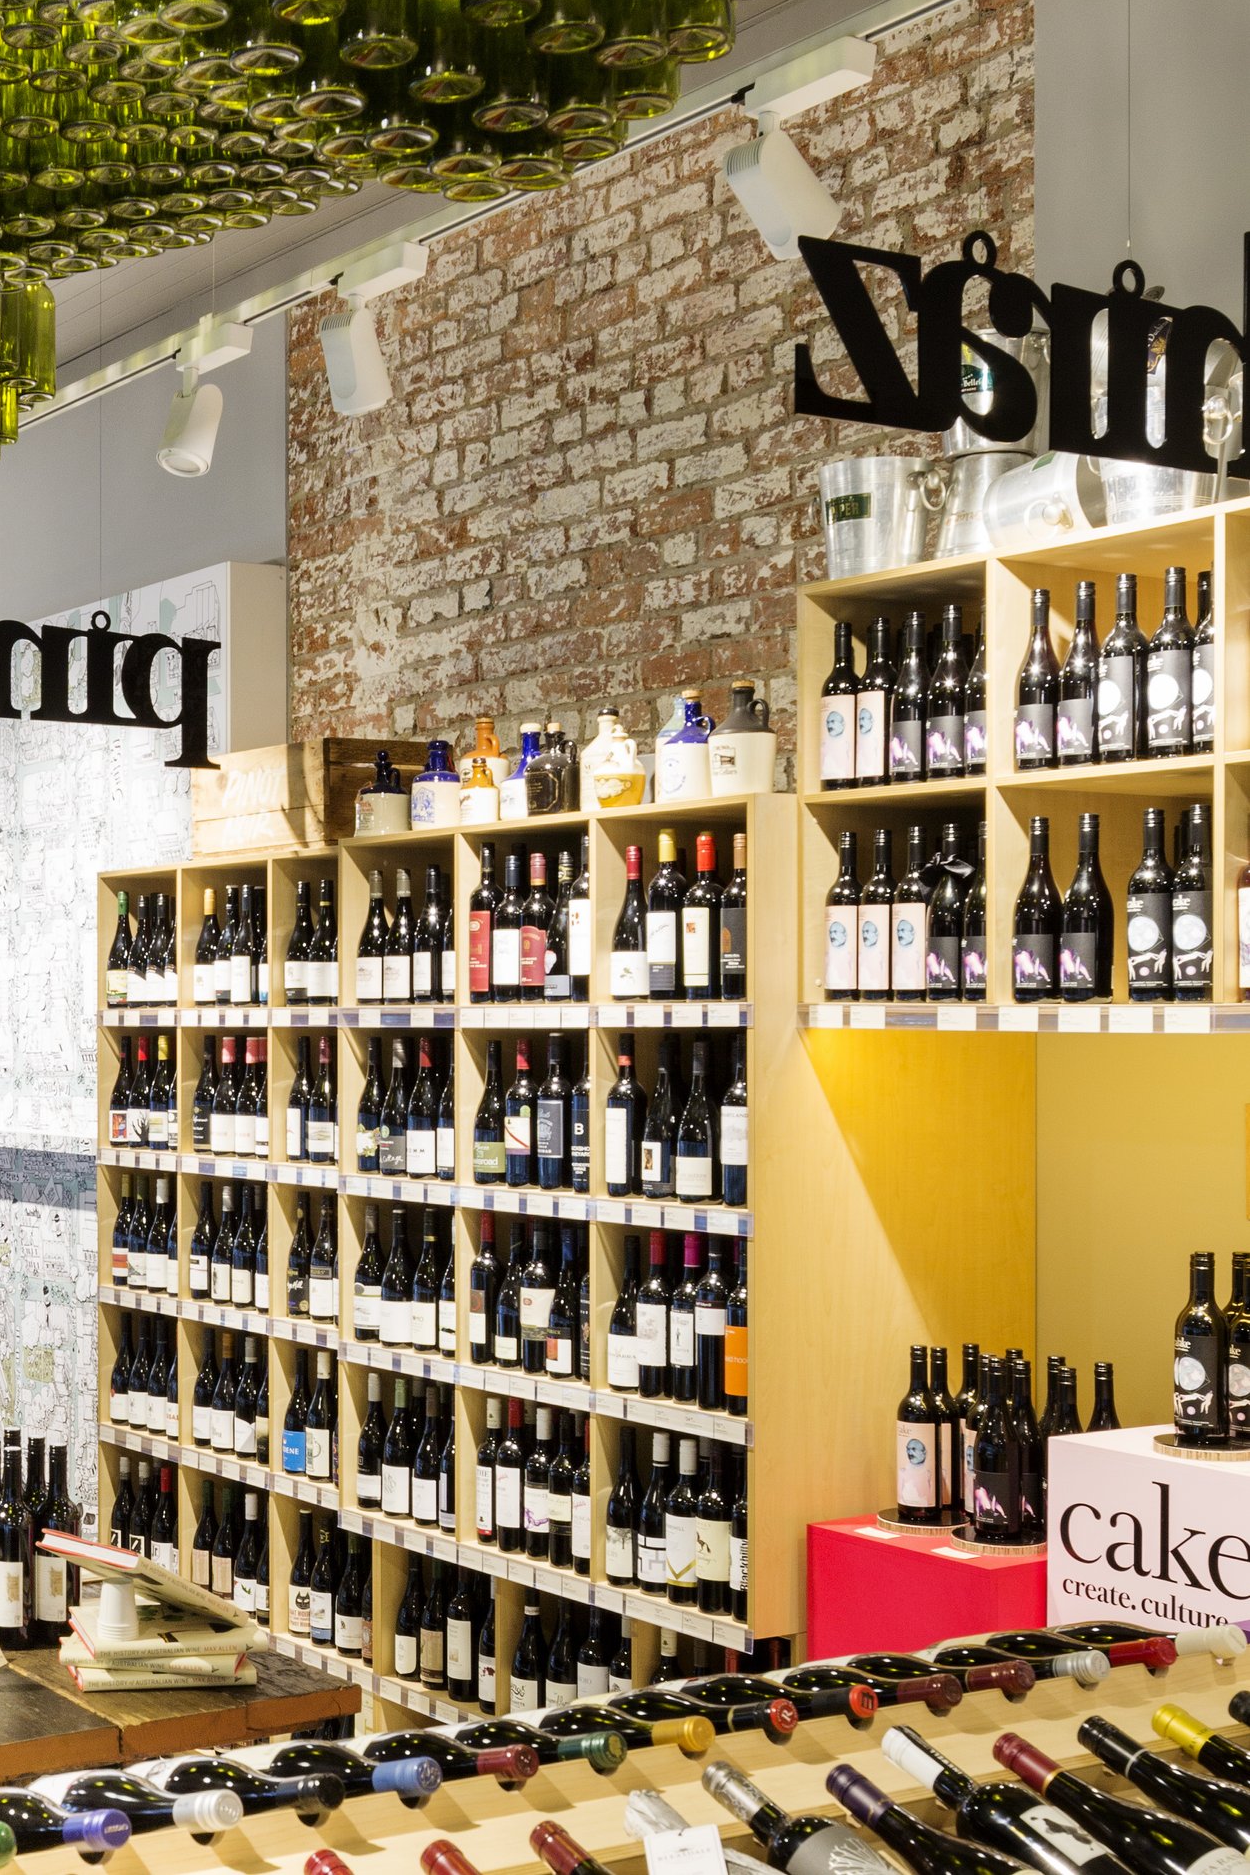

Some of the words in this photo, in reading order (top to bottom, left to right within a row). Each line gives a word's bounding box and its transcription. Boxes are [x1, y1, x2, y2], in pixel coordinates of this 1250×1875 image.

[1060, 1481, 1250, 1601] cake
[1063, 1578, 1136, 1611] create.
[110, 1650, 140, 1658] HISTORY
[147, 1648, 184, 1656] AUSTRALIAN
[219, 1644, 238, 1652] ALLEN
[111, 1661, 149, 1669] AUSTRALIAN
[205, 1675, 226, 1683] ALLEN
